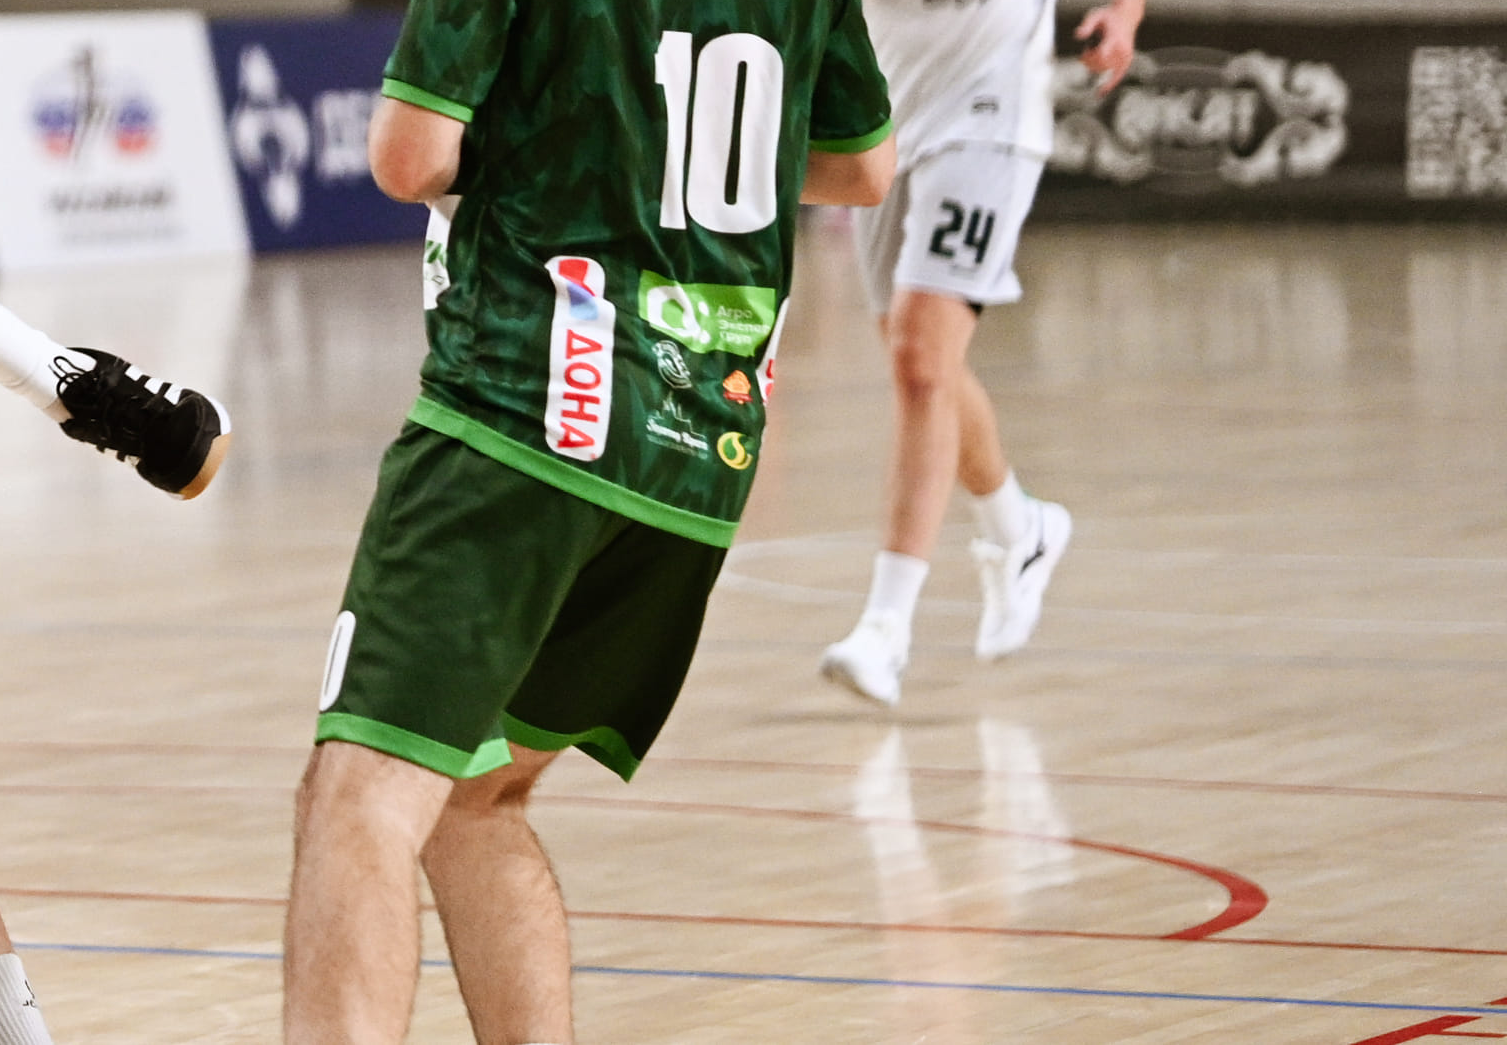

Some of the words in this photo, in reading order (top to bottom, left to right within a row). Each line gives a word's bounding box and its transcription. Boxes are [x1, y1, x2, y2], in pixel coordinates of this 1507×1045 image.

[654, 29, 785, 235] 10
[928, 197, 996, 264] 24
[556, 329, 604, 449] ДОНА
